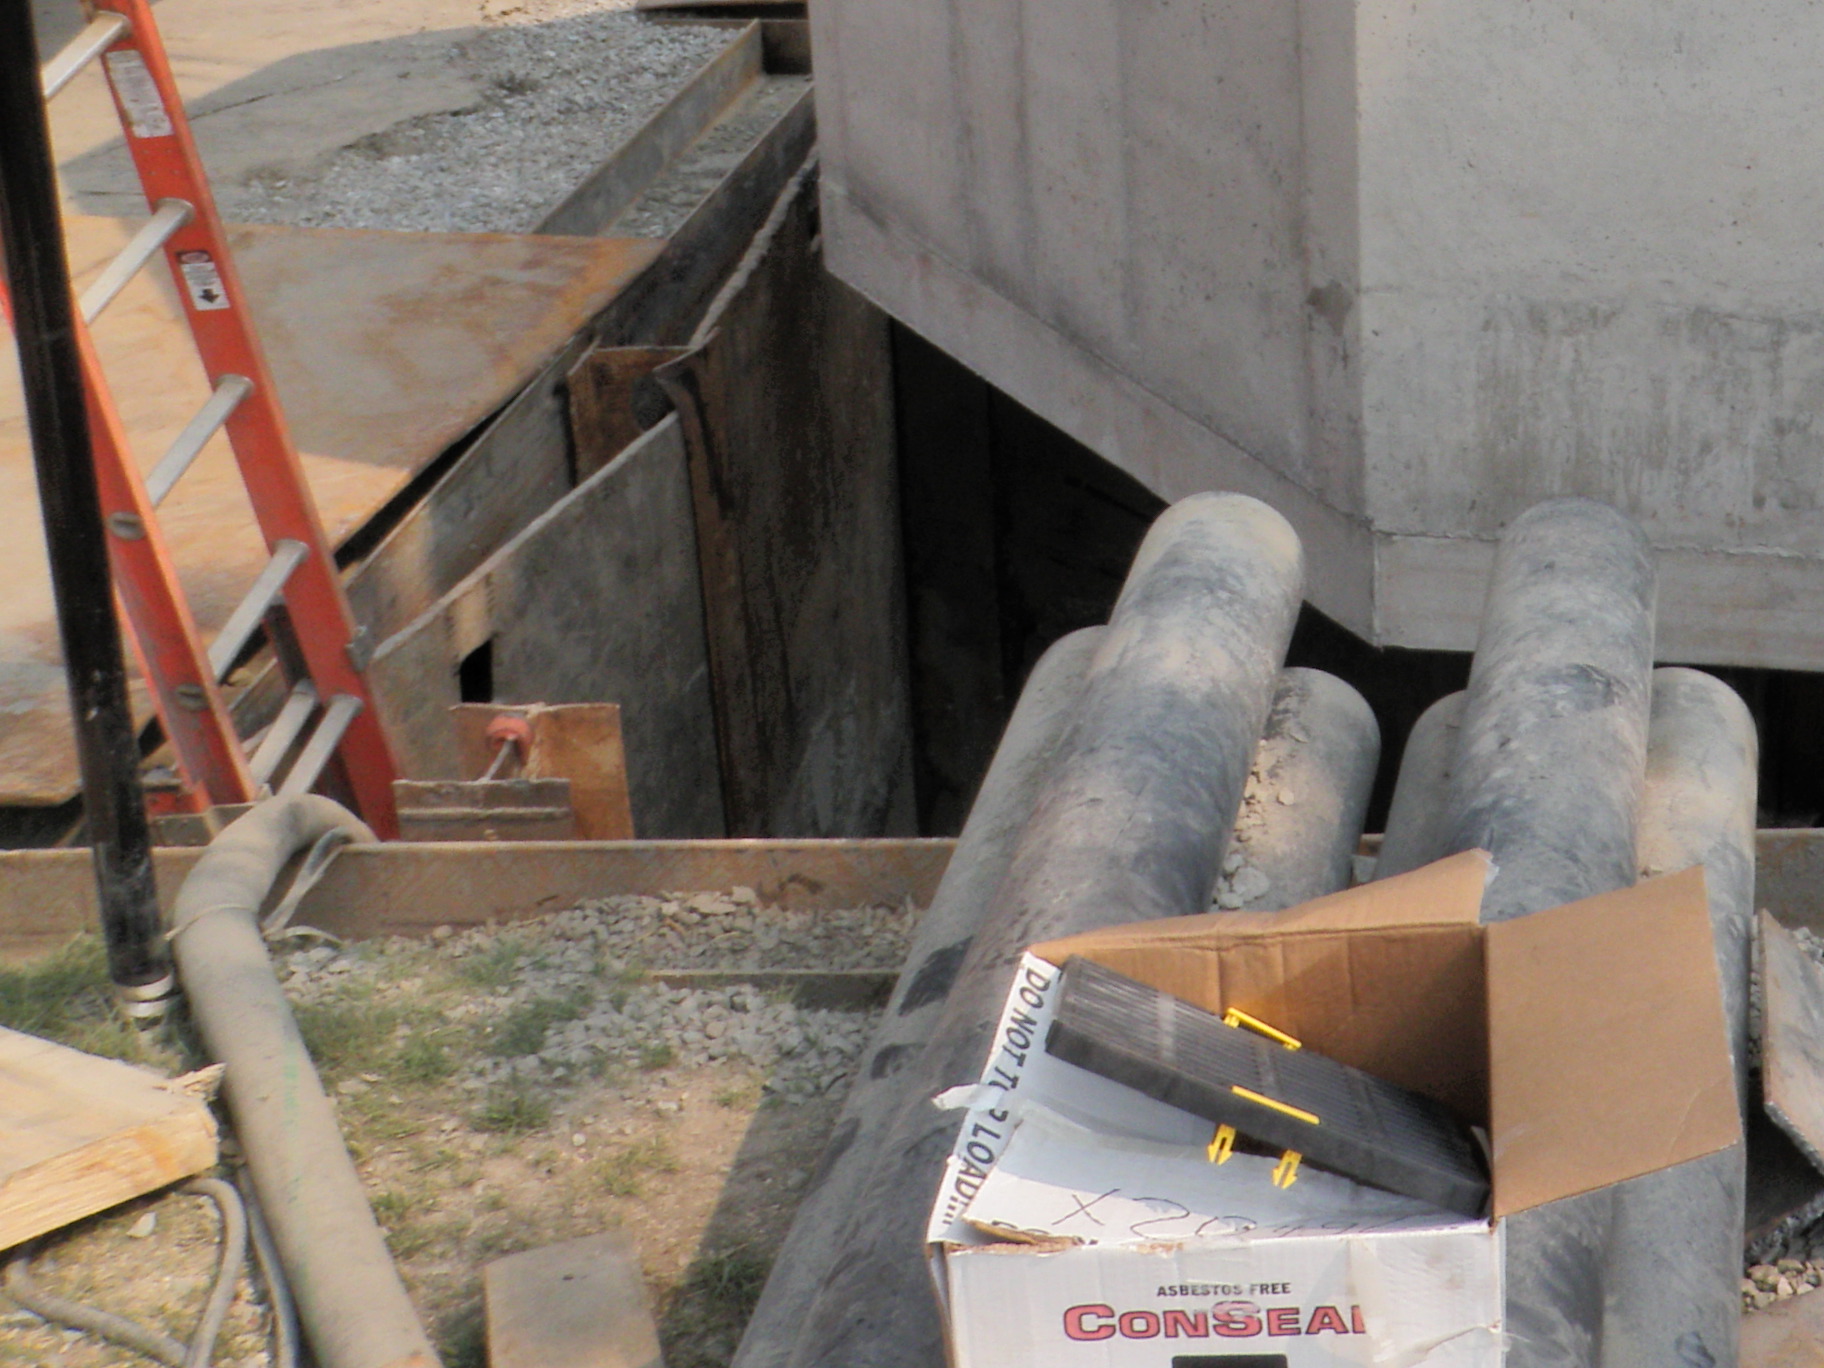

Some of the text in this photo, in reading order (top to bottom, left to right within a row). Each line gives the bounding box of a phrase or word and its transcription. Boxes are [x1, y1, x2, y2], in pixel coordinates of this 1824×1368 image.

[1019, 967, 1050, 1009] DO
[1002, 1007, 1038, 1068] NOT
[1156, 1282, 1292, 1297] ASBESTOS FREE
